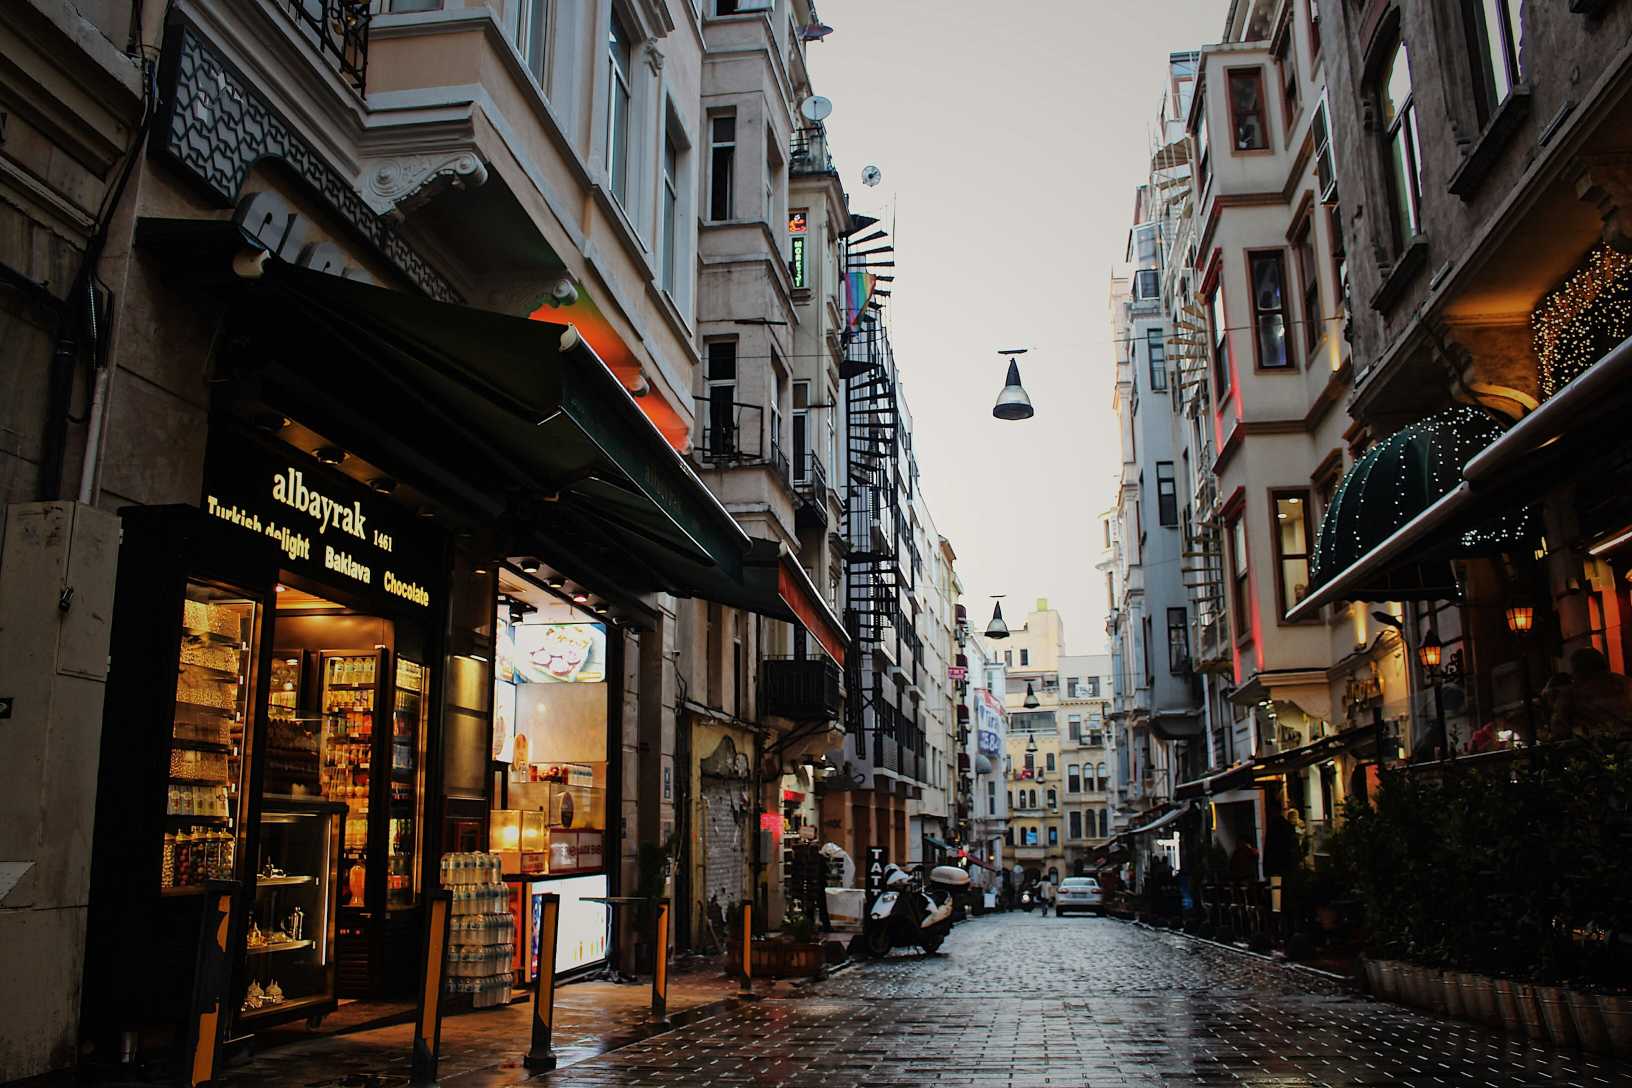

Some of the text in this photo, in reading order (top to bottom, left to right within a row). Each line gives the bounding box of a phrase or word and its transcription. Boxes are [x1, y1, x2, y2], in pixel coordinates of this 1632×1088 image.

[272, 467, 393, 552] albayrak 1461
[265, 521, 310, 560] delight
[325, 545, 371, 584] Baklava
[383, 570, 429, 607] Chocolate
